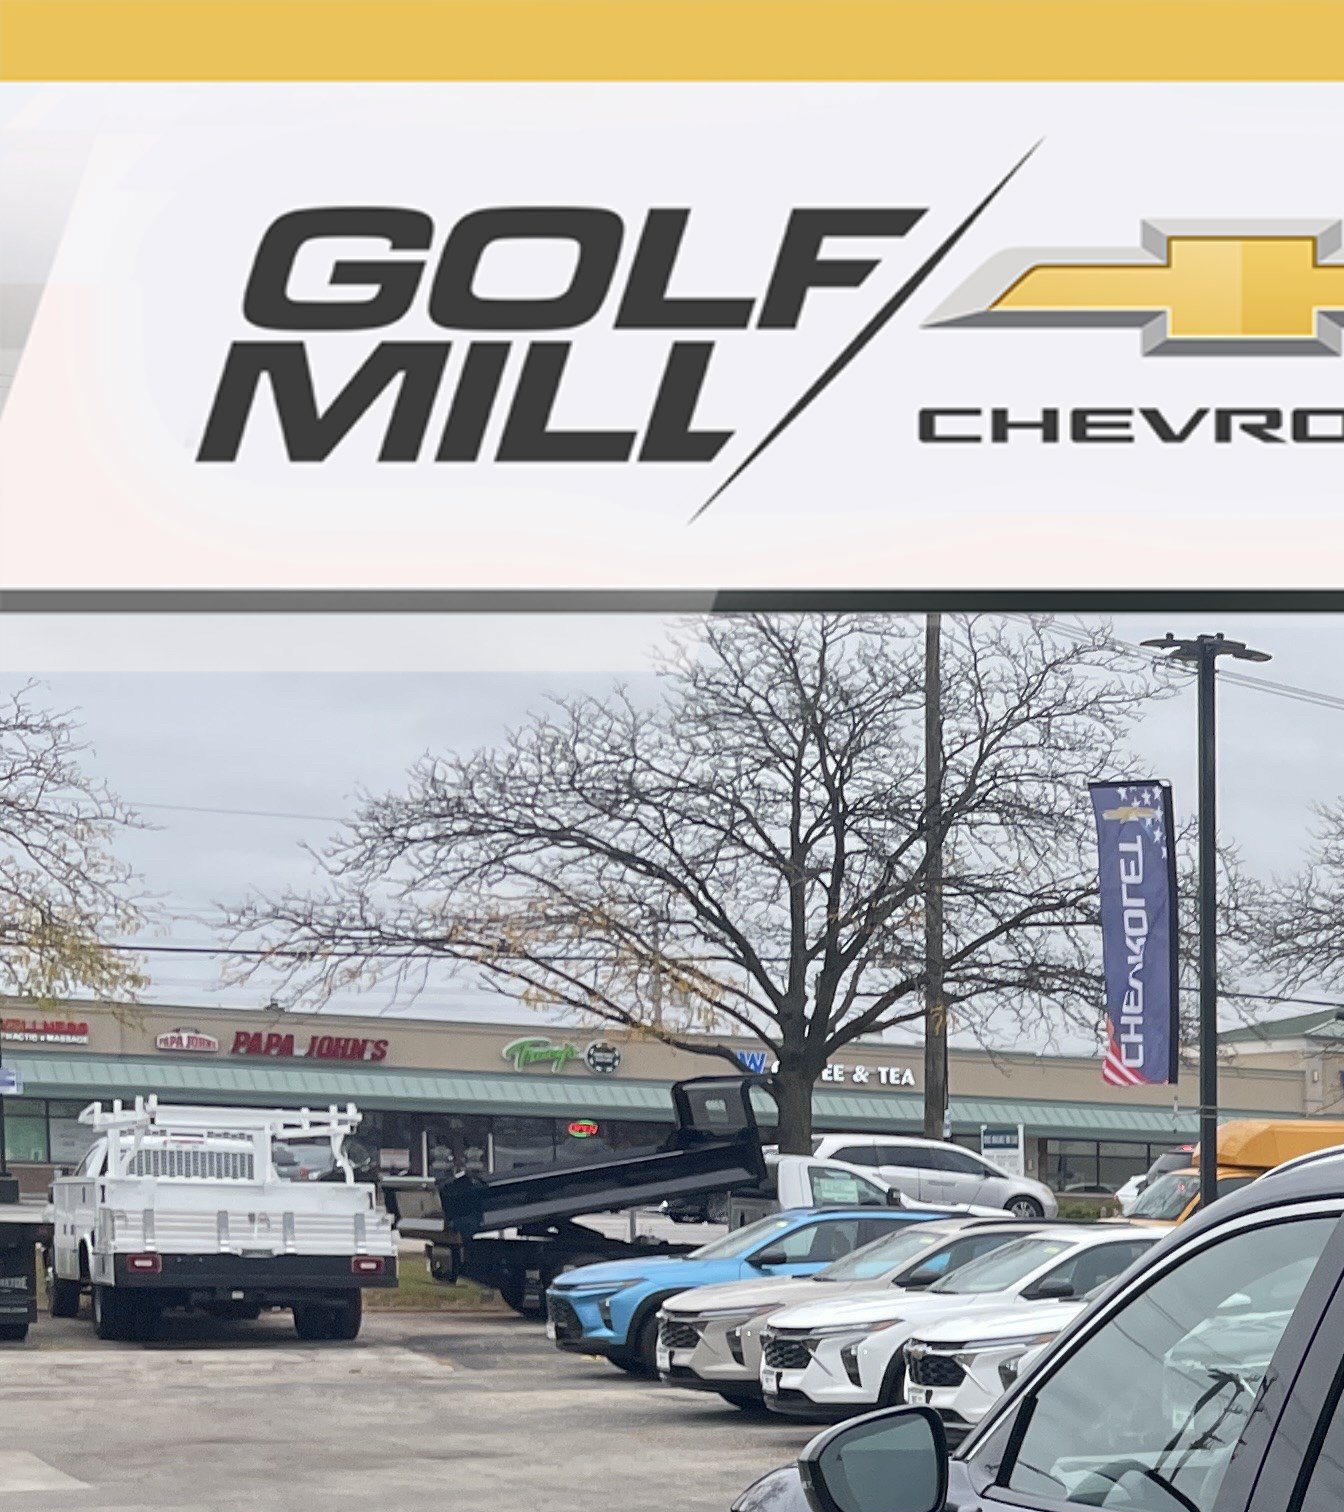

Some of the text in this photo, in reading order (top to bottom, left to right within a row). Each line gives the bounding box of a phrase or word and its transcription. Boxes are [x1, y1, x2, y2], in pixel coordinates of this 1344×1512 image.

[231, 1031, 389, 1062] PAPA JOHN'S
[852, 1065, 870, 1084] &
[877, 1066, 916, 1087] TEA
